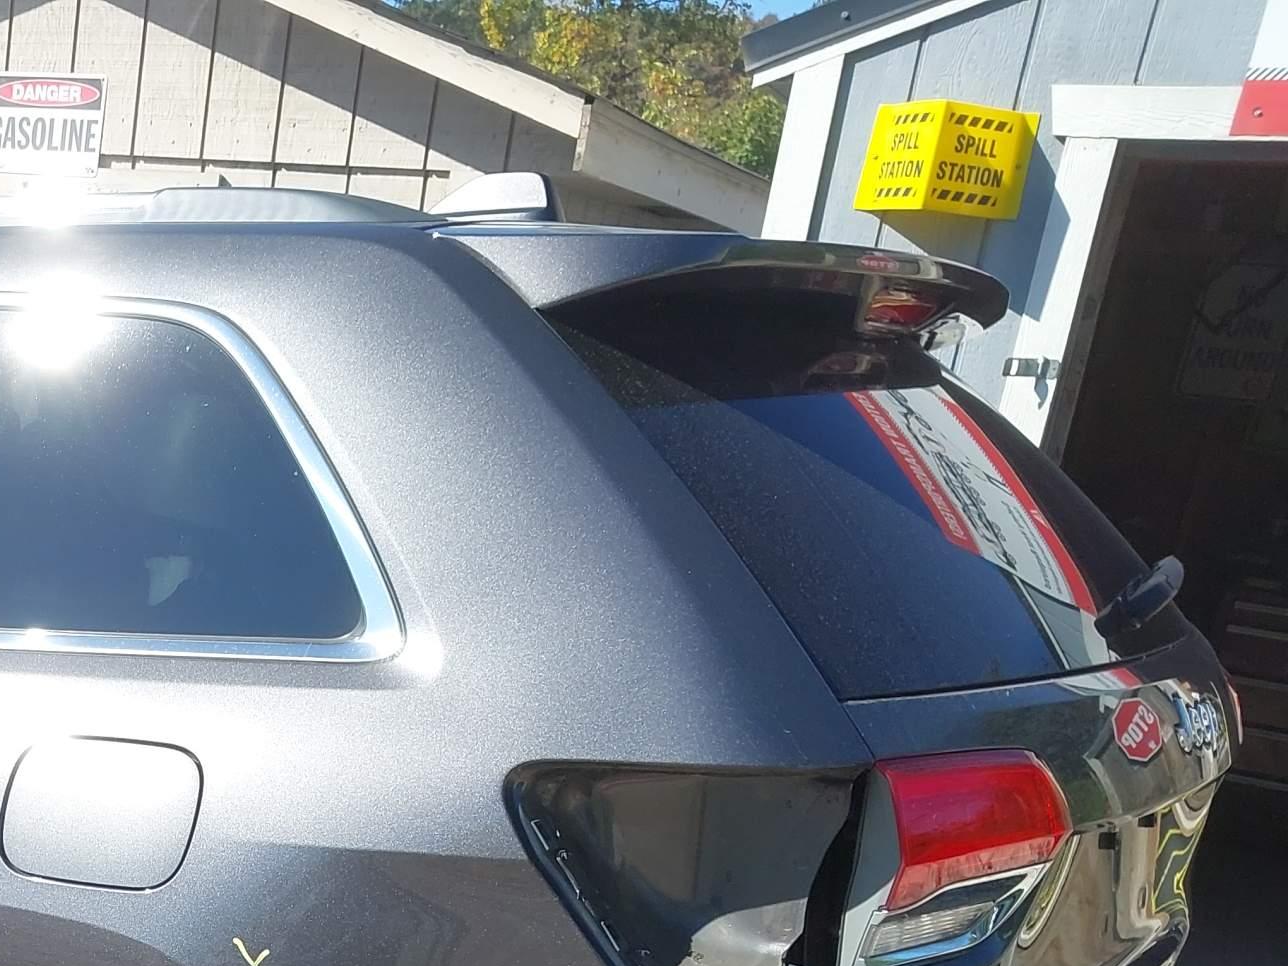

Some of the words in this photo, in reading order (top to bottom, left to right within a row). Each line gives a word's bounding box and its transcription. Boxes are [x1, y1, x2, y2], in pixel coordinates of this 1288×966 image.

[12, 84, 82, 102] DANGER
[891, 132, 920, 151] SPILL
[955, 135, 997, 158] SPILL
[879, 160, 924, 179] STATION
[936, 161, 1004, 188] STATION
